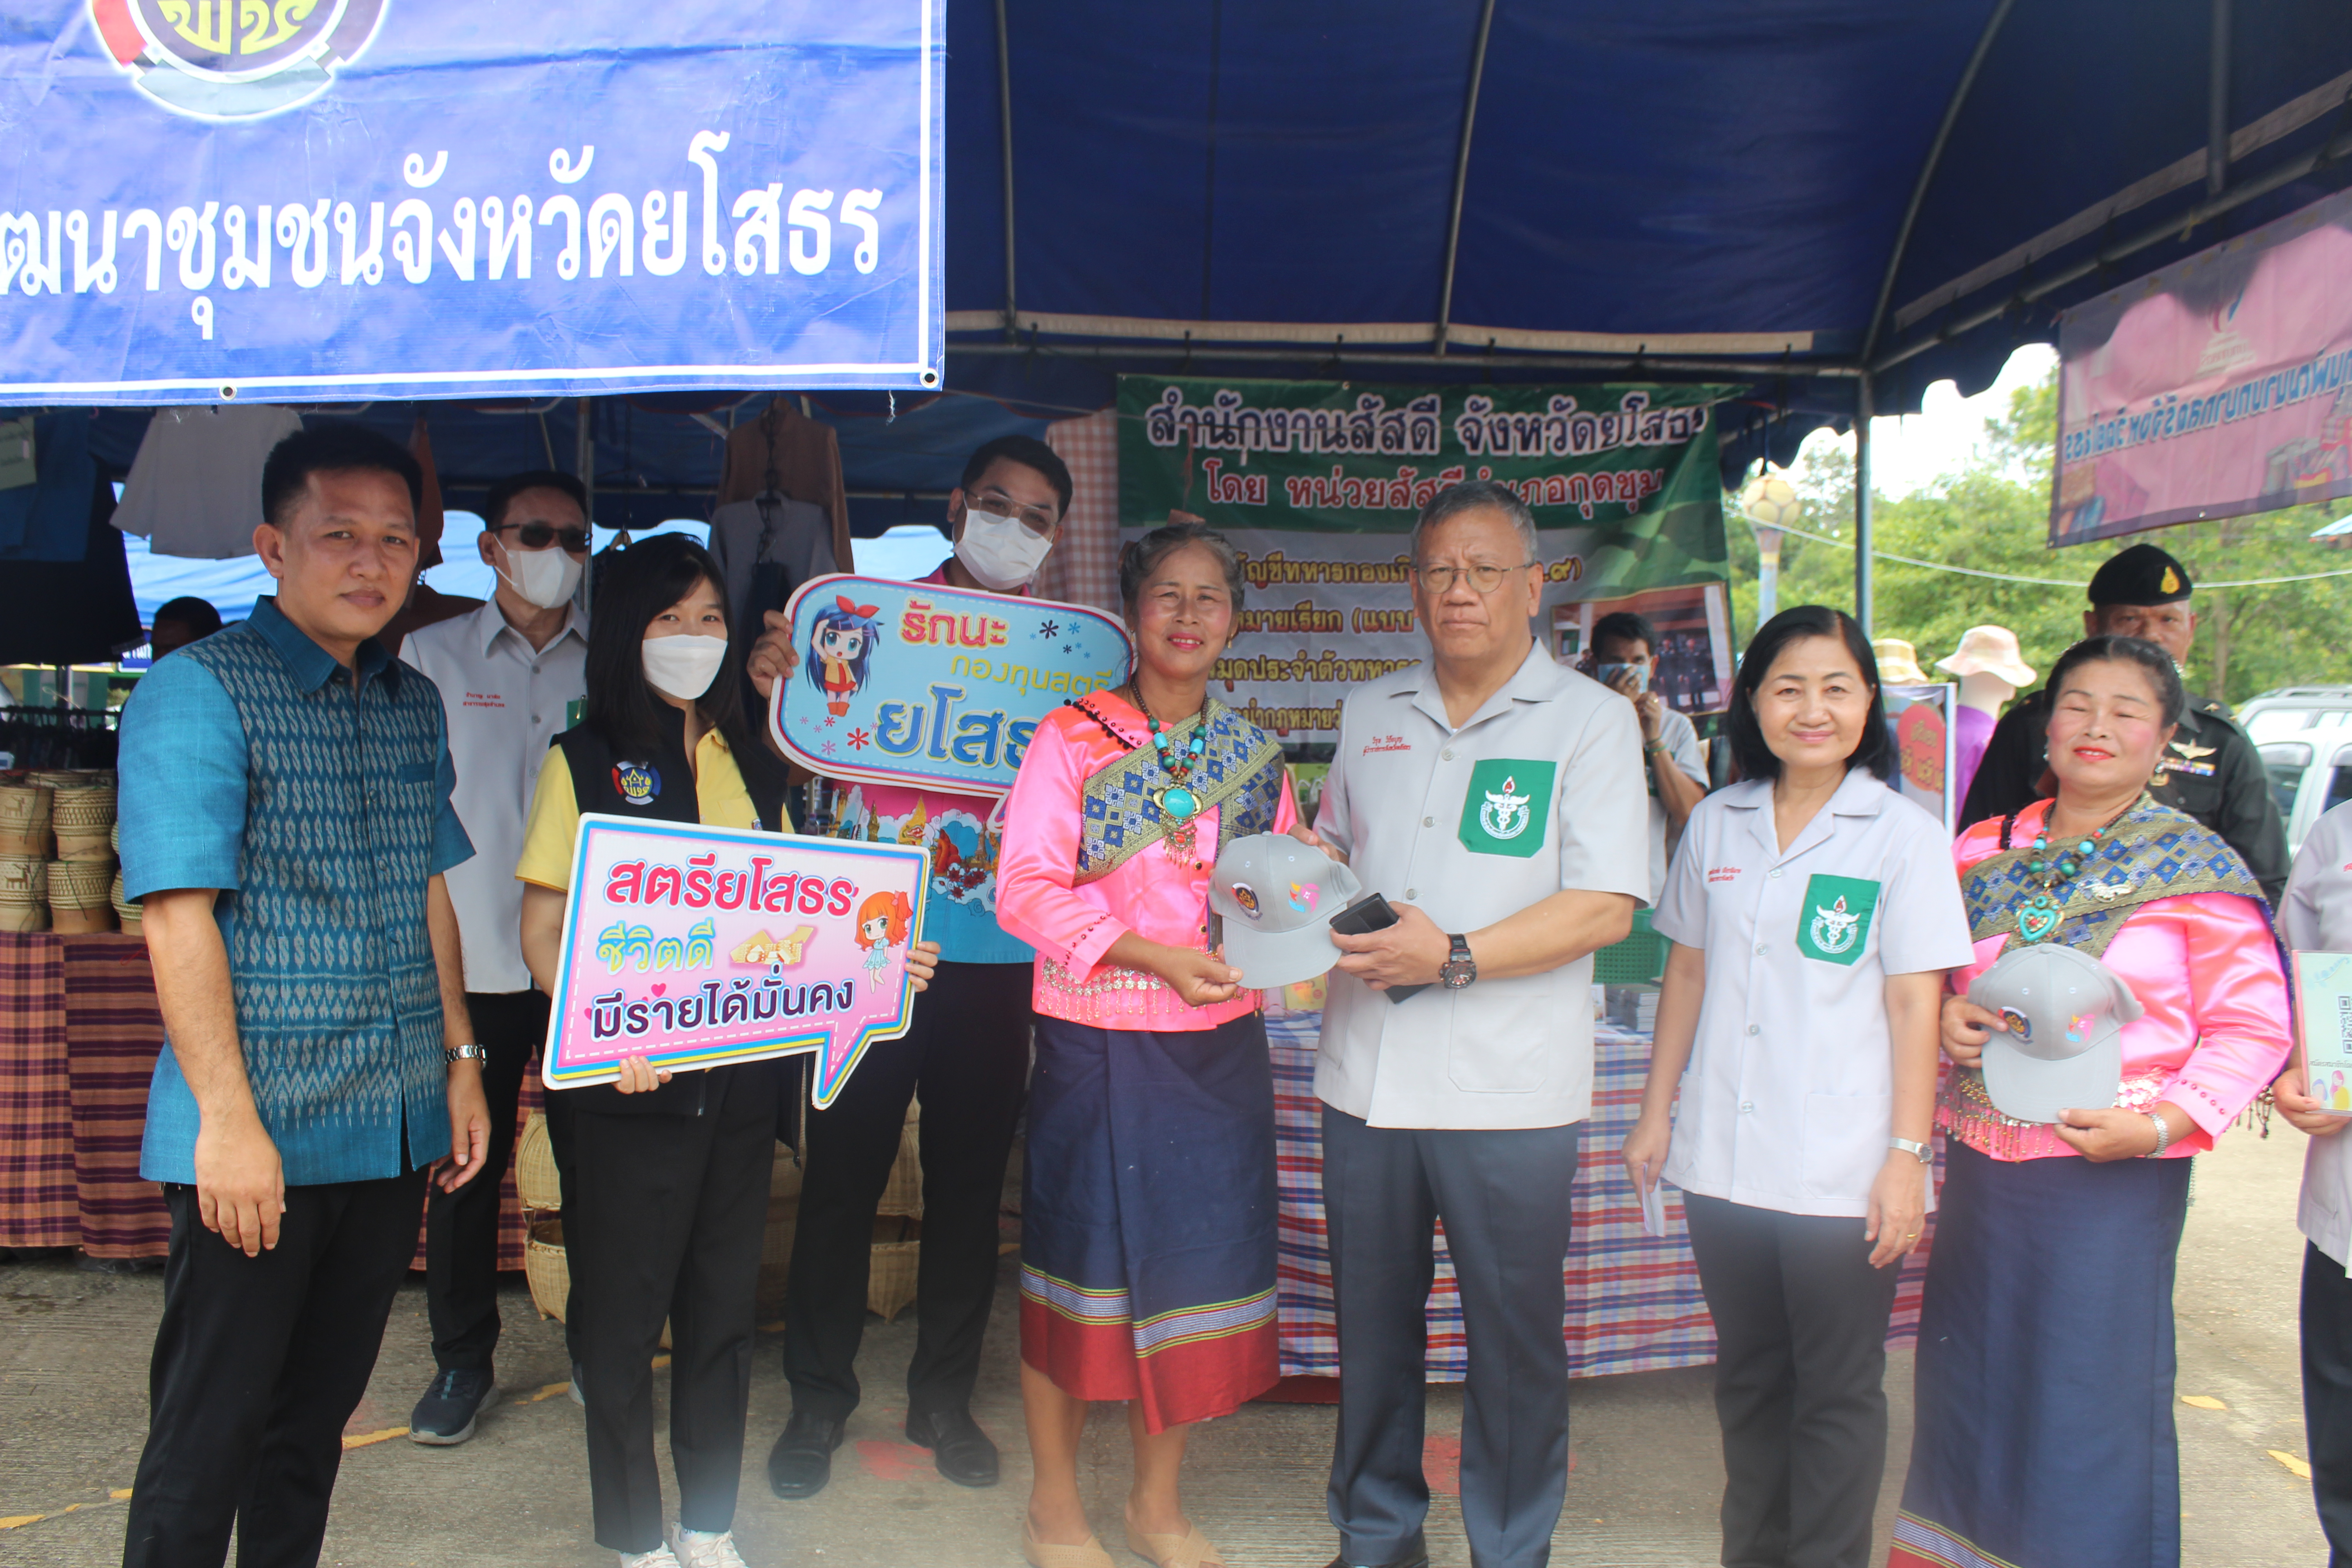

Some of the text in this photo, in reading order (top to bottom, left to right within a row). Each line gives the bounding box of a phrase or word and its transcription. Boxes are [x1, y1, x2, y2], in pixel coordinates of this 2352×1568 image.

[1147, 387, 1441, 454] สำนักงานสัสดี
[1203, 457, 1268, 505] โดย
[901, 599, 1008, 647] รักนะ
[605, 851, 854, 918] สตรียโสธร
[598, 918, 715, 975] ชีวิตดี
[591, 962, 855, 1041] มีรายได้มั่นคง
